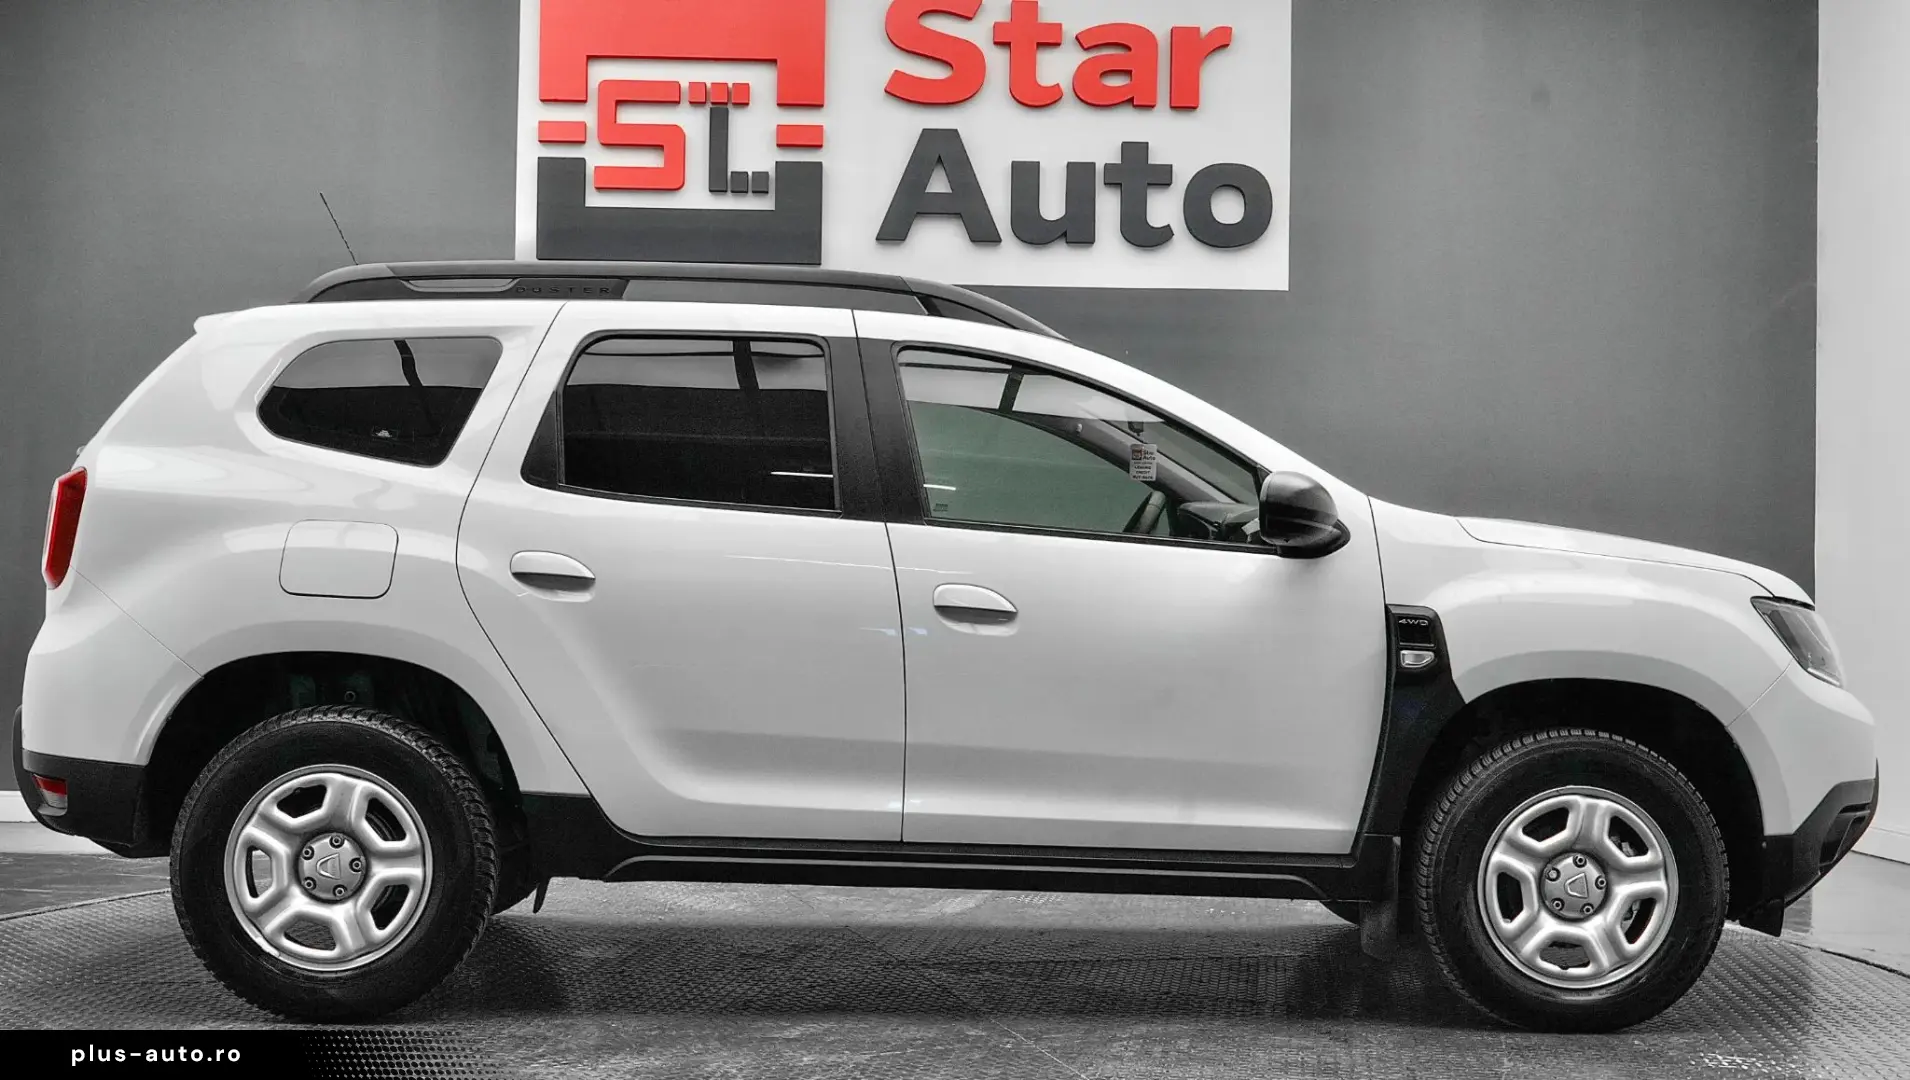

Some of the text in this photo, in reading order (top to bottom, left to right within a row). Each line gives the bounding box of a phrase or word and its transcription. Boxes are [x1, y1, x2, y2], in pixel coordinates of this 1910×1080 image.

[884, 0, 1233, 110] Star
[875, 127, 1273, 249] Auto
[515, 286, 610, 294] DUSTER
[1398, 618, 1429, 626] 4WD
